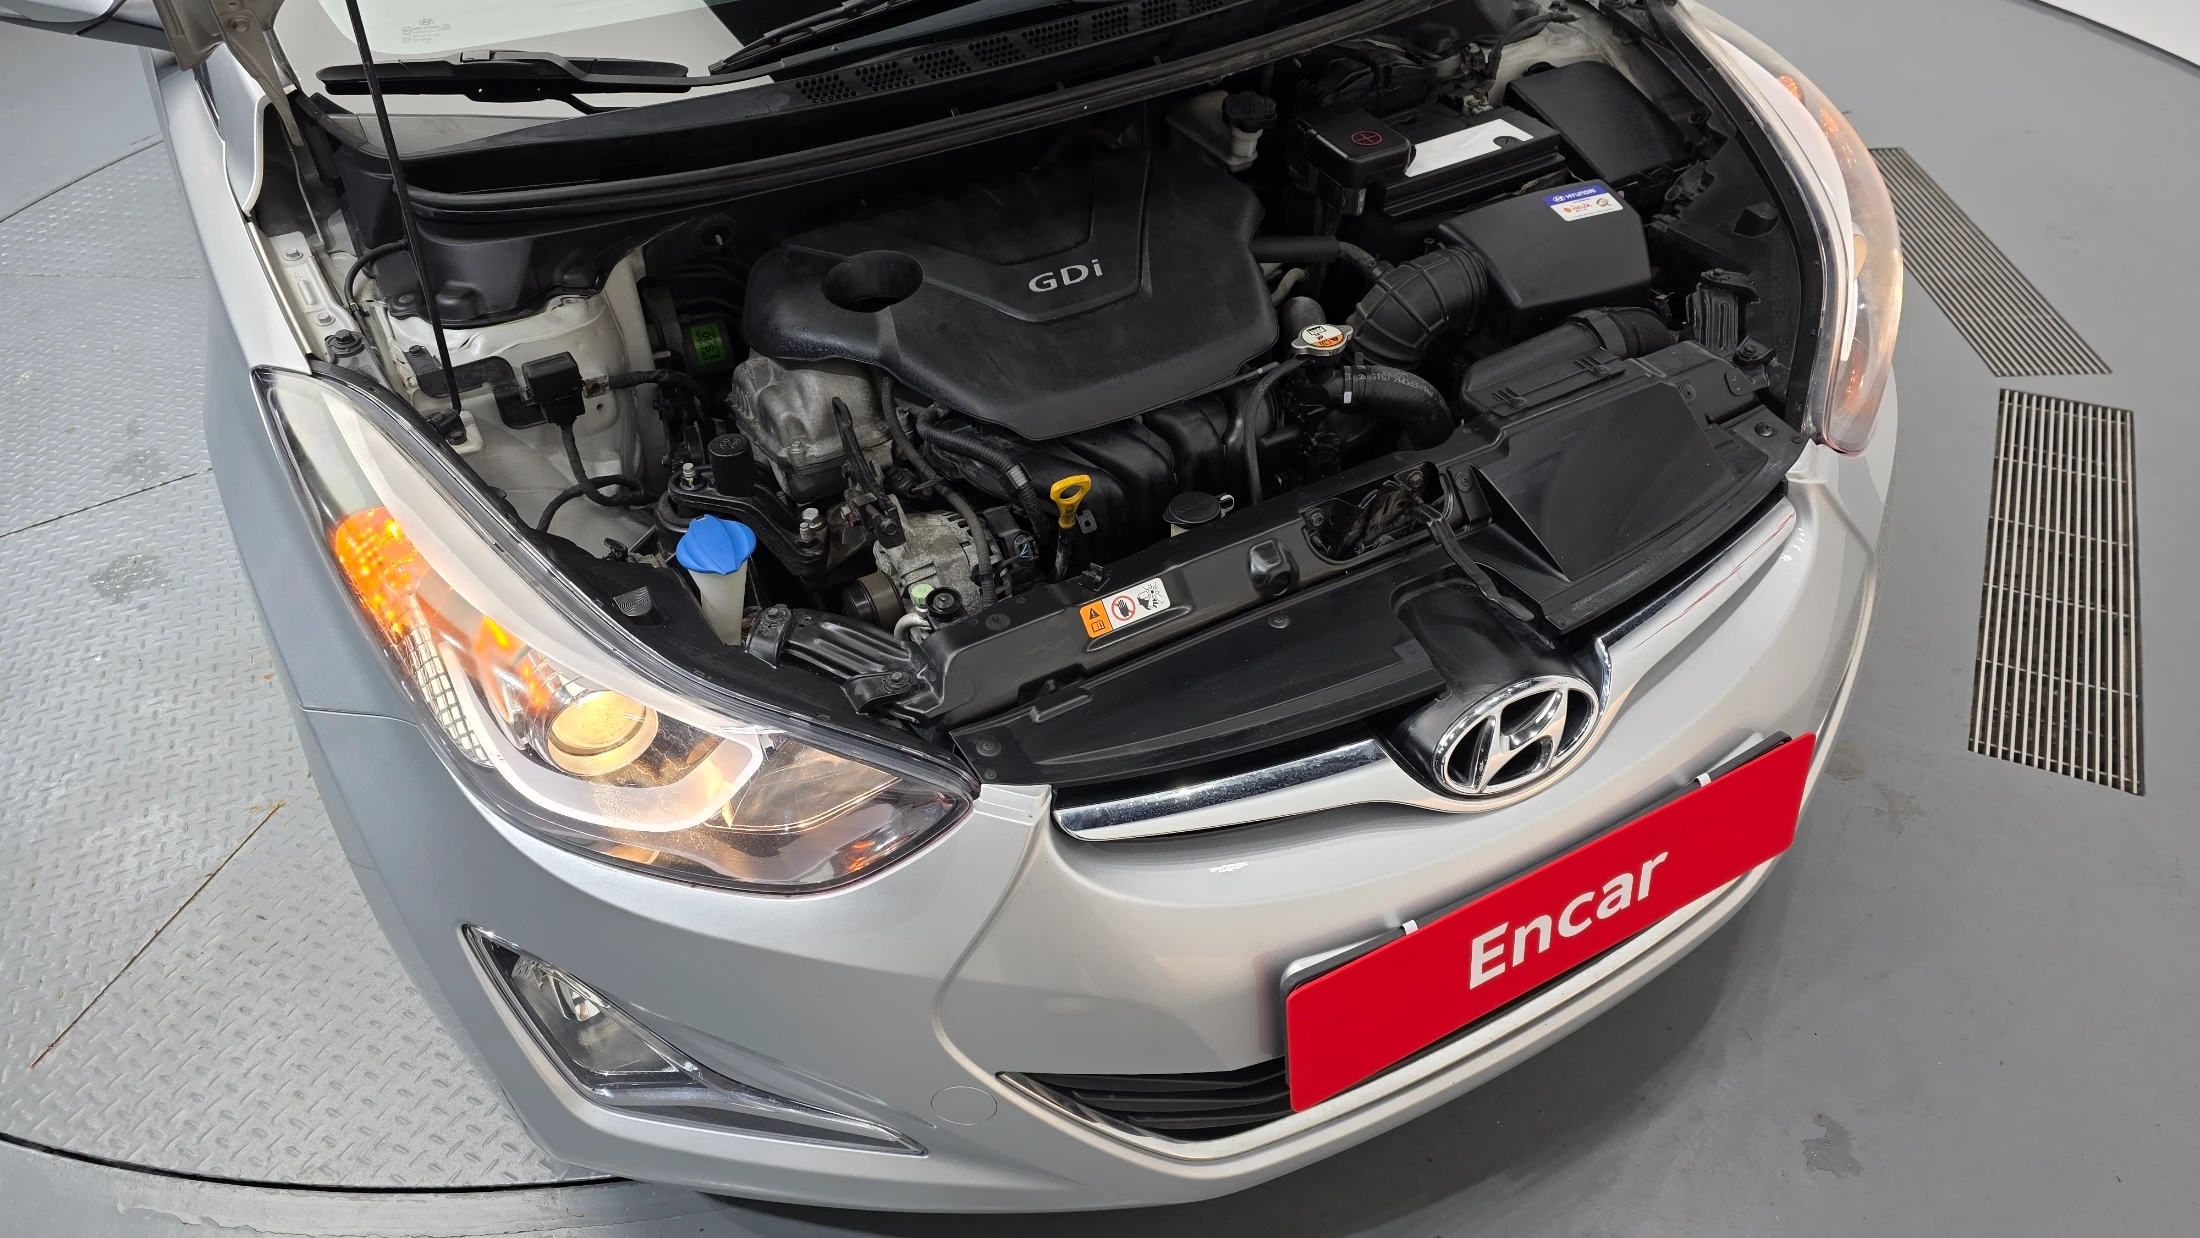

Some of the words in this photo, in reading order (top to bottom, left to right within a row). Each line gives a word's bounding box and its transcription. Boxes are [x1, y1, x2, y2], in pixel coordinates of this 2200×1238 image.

[1565, 188, 1597, 199] HYUNDAI
[1028, 259, 1103, 292] GDi
[1469, 851, 1669, 990] Encar
